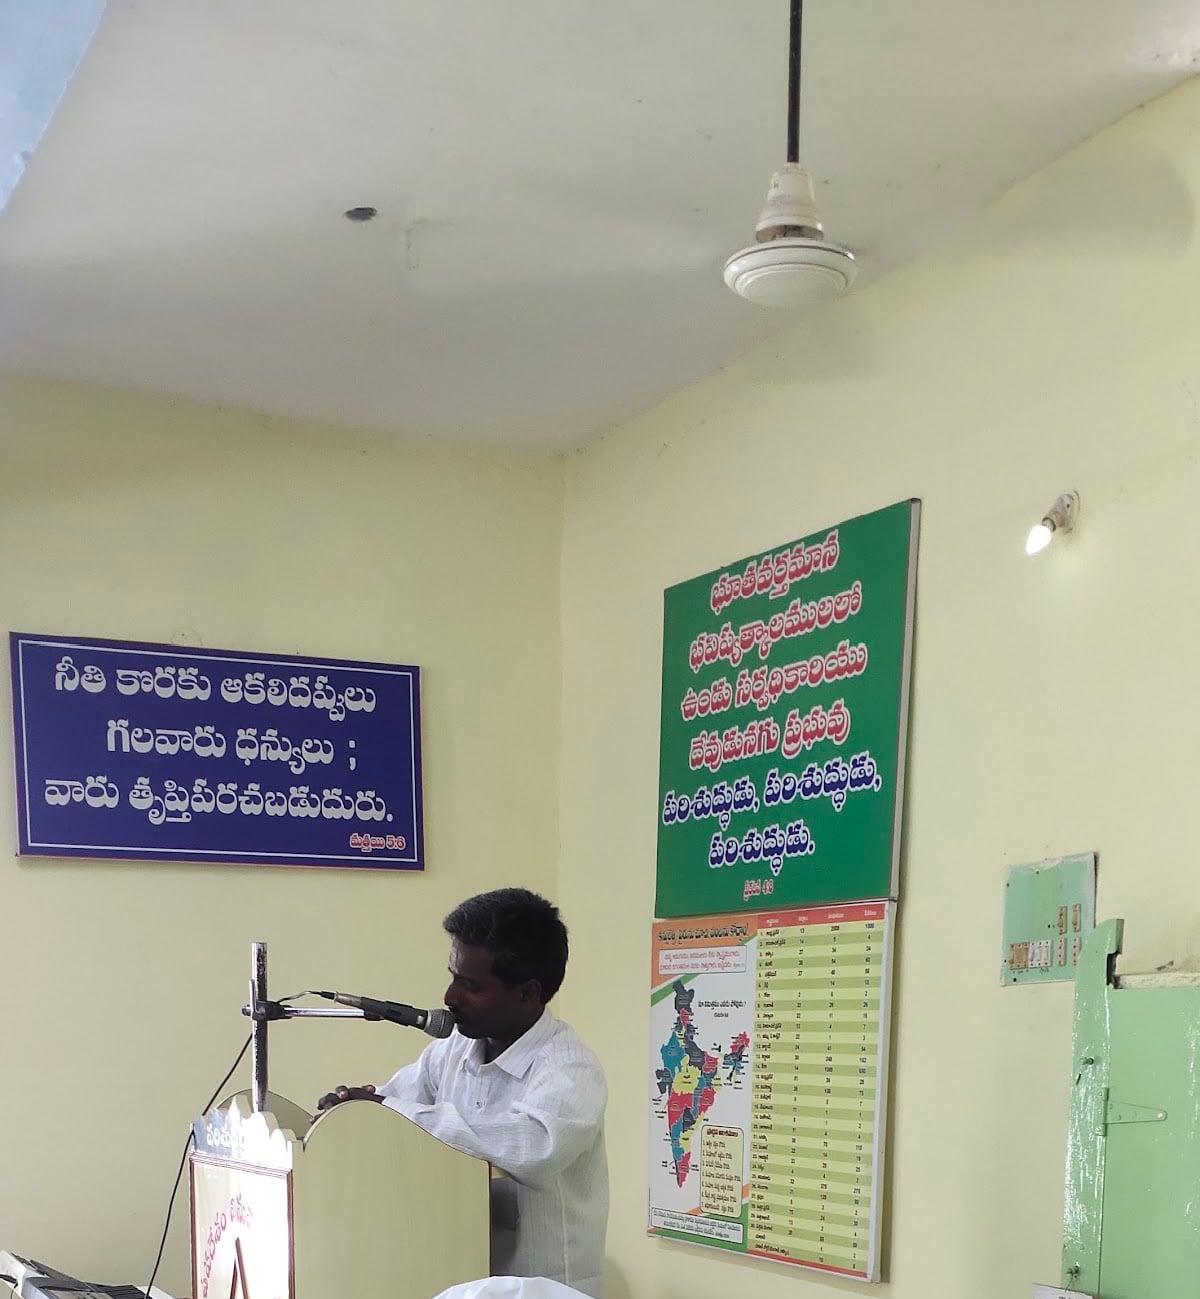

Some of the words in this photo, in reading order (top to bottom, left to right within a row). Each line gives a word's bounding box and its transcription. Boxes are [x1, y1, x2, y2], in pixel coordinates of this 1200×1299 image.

[56, 655, 107, 694] నీతి
[116, 666, 212, 701] కొరకు
[681, 677, 732, 721] ఉండు
[106, 719, 227, 758] గలవారు
[235, 727, 334, 775] ధన్యులు
[689, 715, 780, 772] దేవుడునగు
[782, 697, 850, 760] ప్రభువు
[44, 775, 120, 809] వారు
